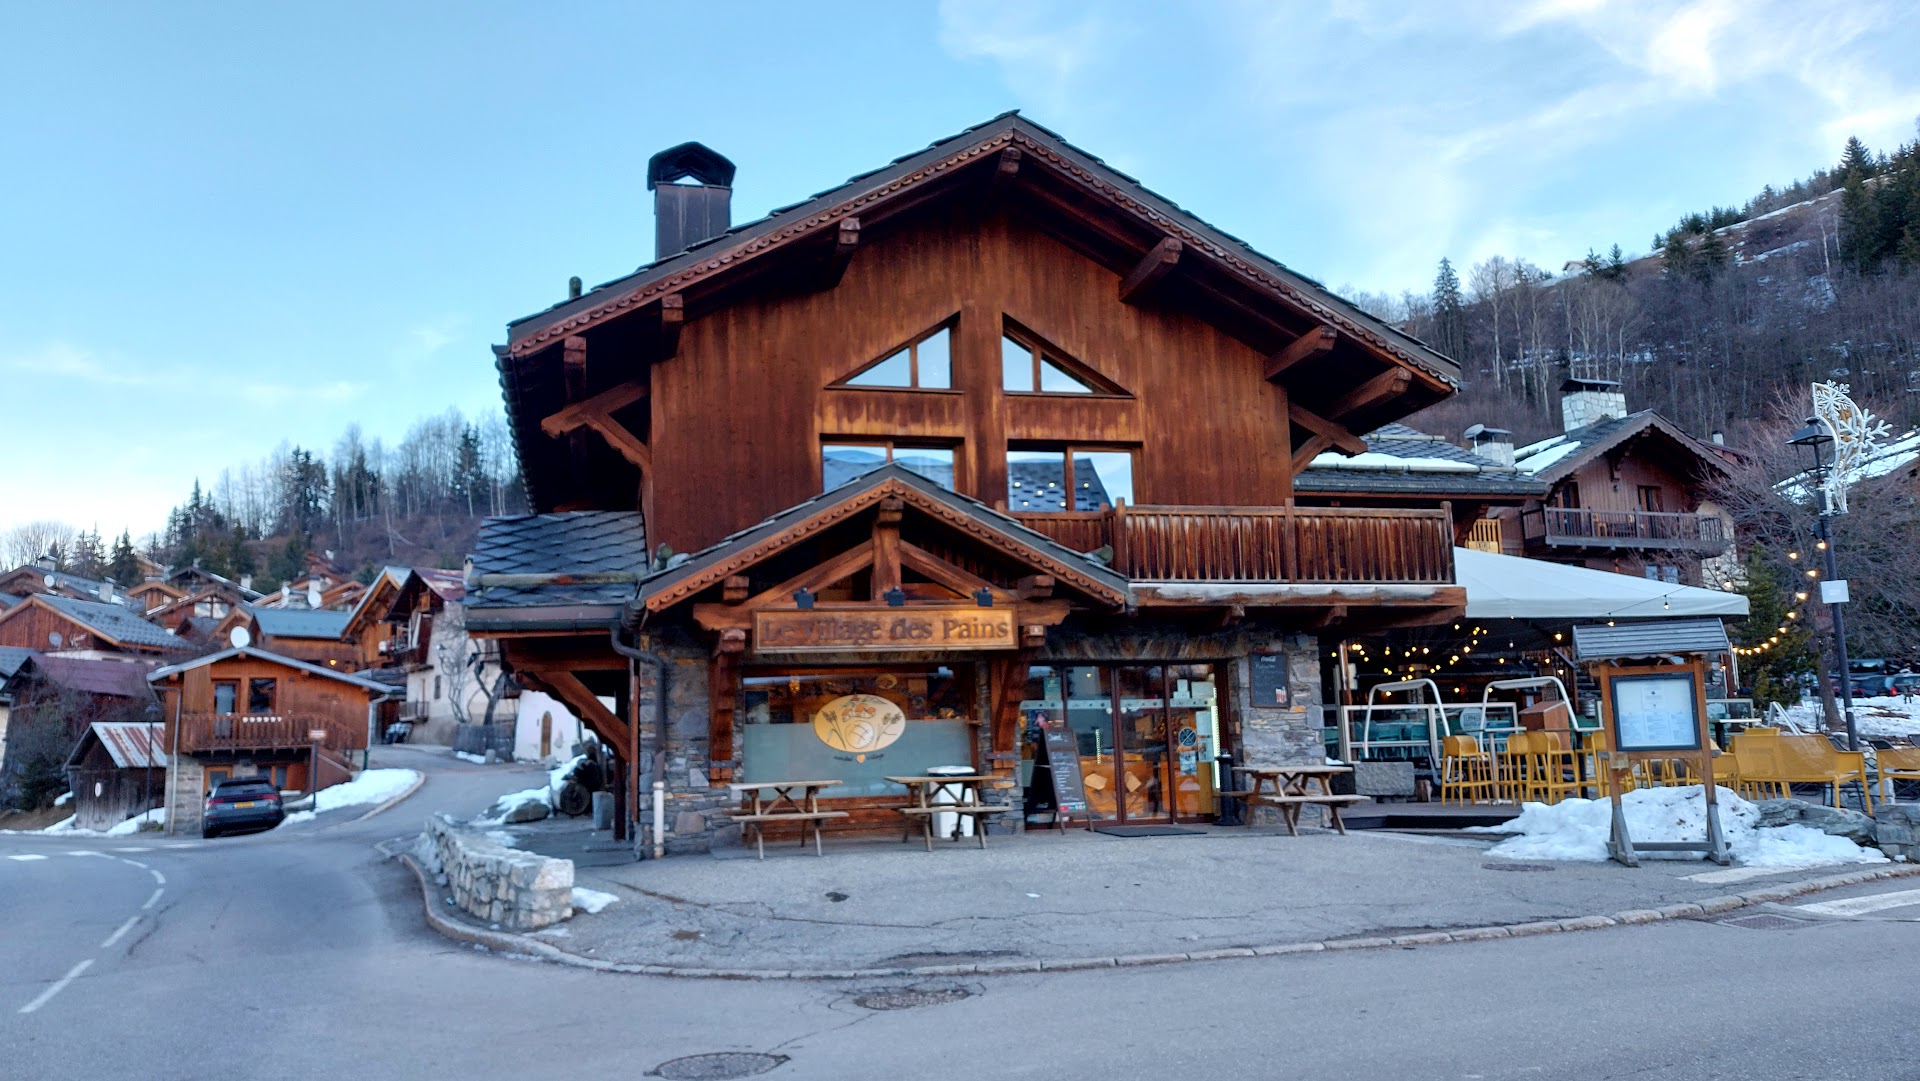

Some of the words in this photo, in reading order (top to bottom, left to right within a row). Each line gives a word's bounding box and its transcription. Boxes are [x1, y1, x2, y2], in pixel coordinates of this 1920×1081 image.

[763, 620, 794, 641] Le
[799, 617, 881, 646] Village
[890, 618, 933, 640] des
[943, 617, 1009, 640] Pains
